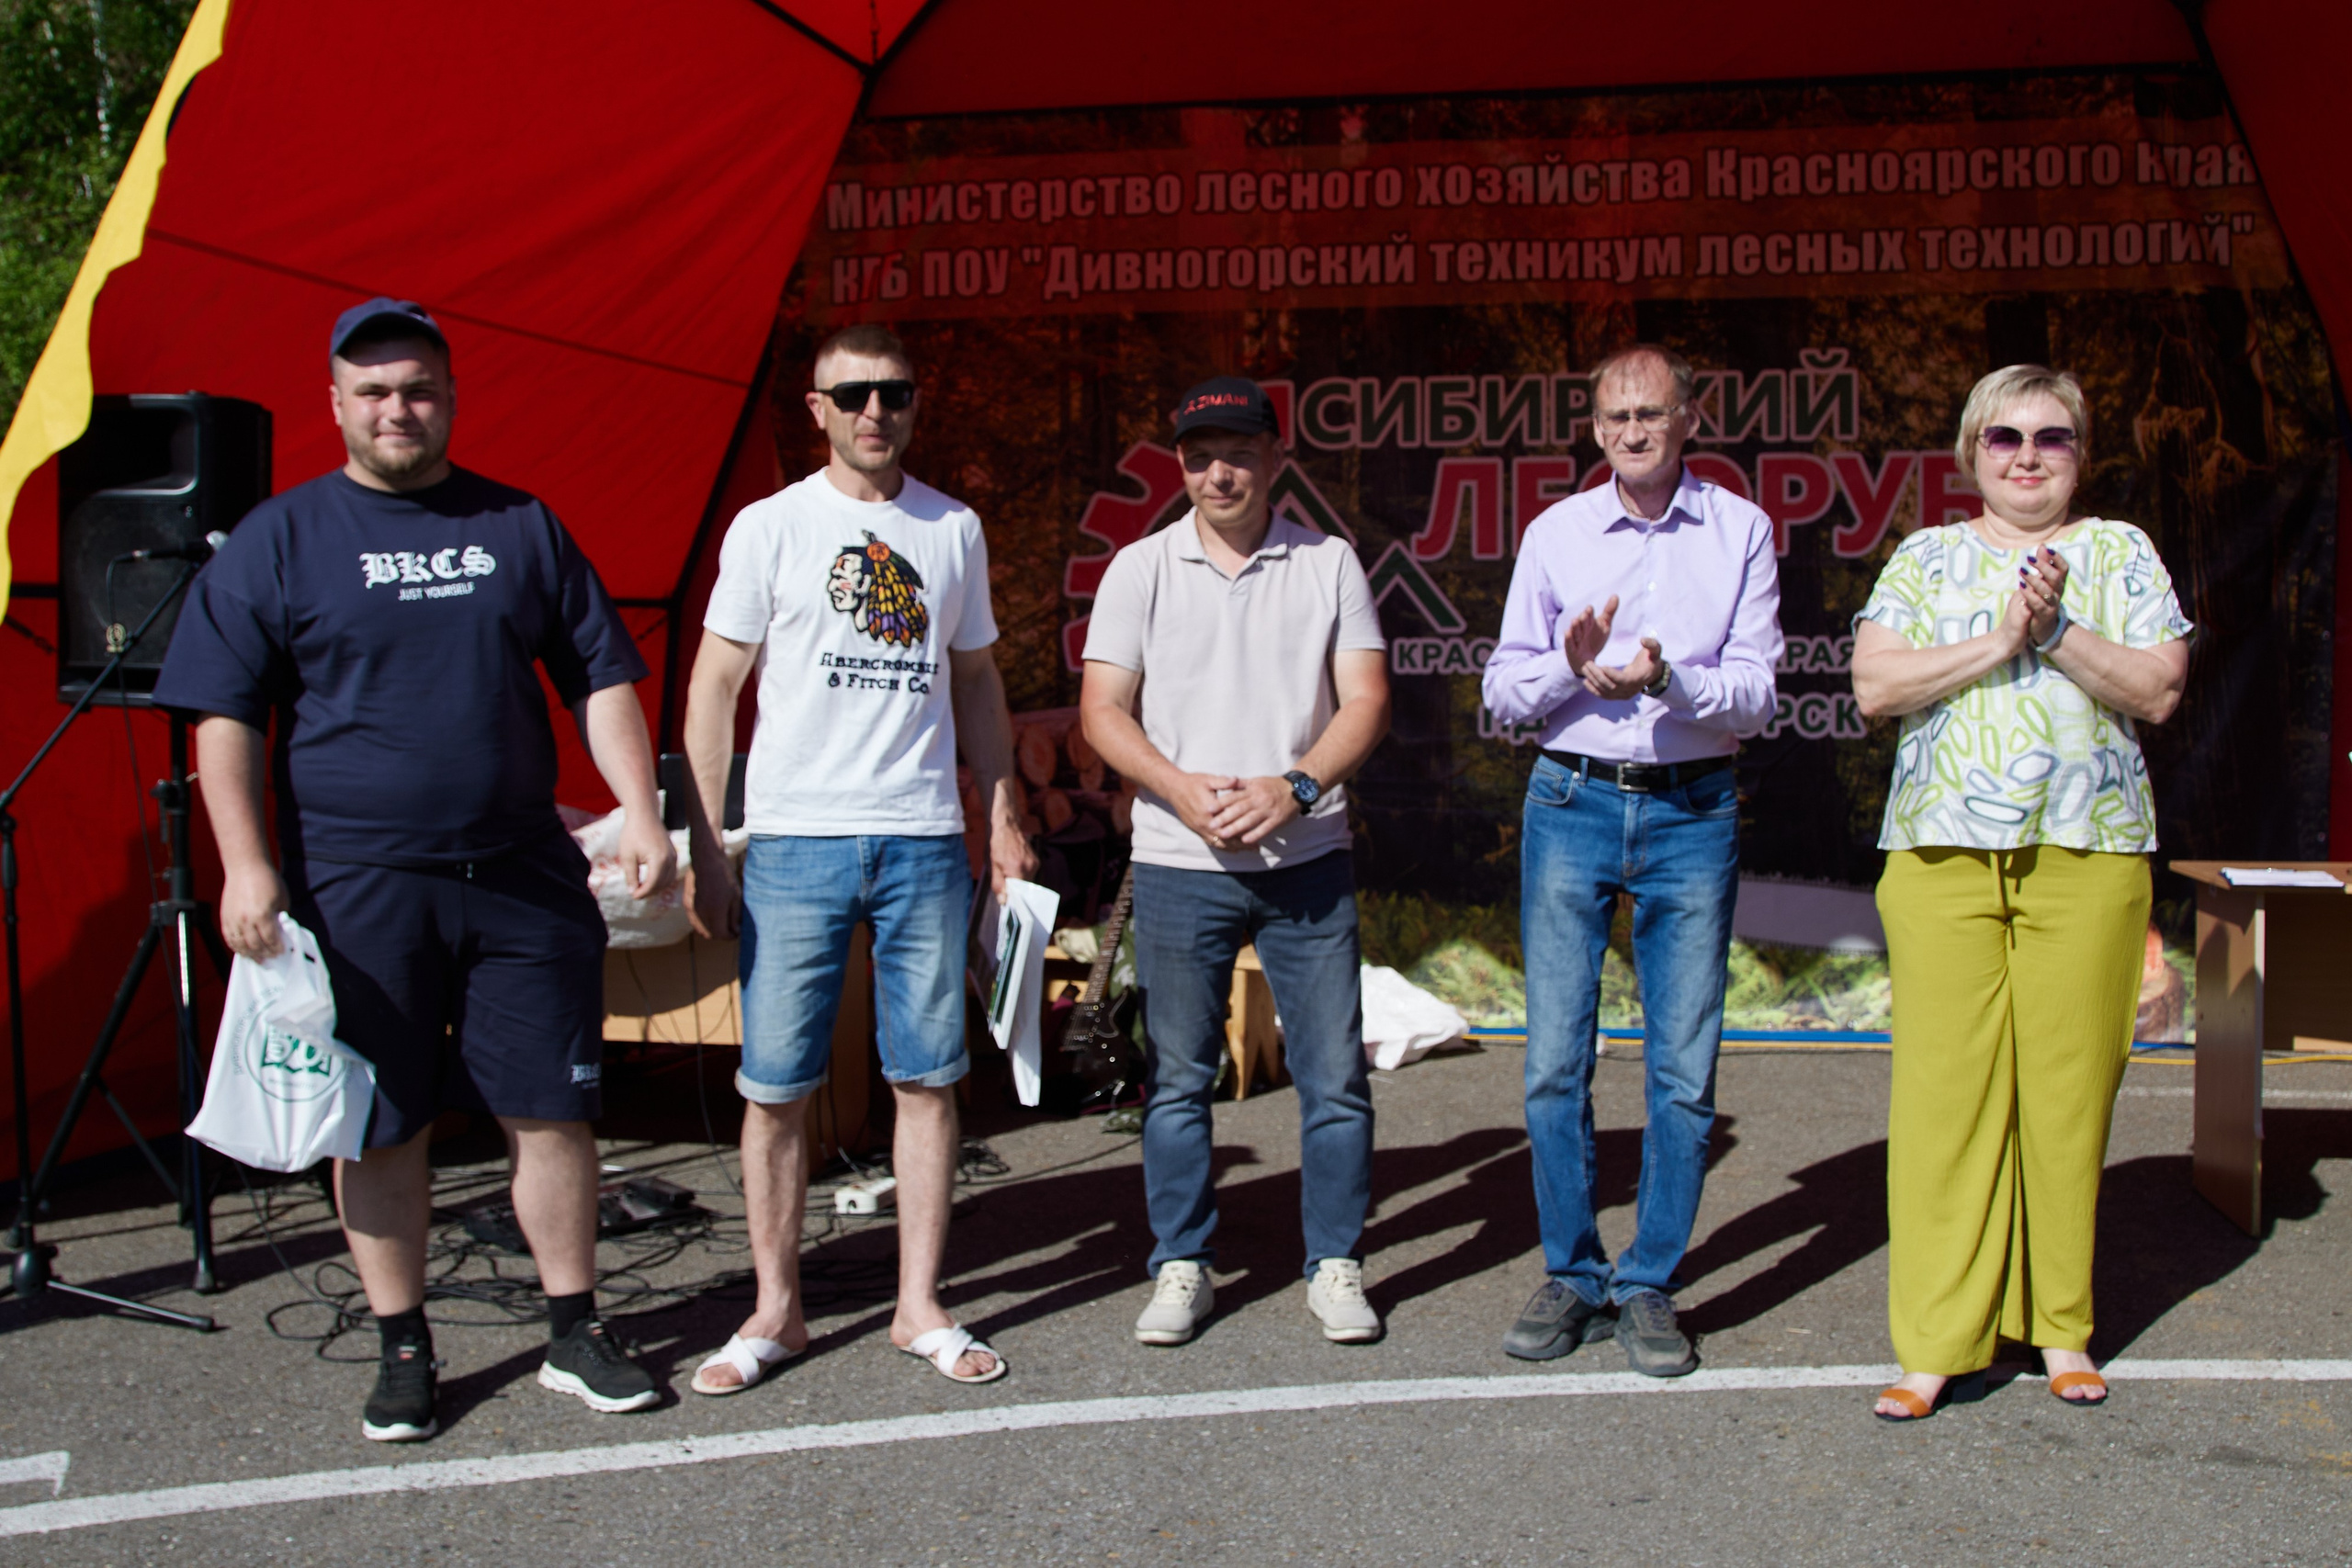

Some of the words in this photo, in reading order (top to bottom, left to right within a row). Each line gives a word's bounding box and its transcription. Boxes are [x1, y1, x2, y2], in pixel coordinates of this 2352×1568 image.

[828, 176, 1182, 230] Министерство
[1193, 167, 1403, 213] лесного
[1416, 151, 1692, 208] хозяйства
[1705, 143, 2120, 197] Красноярского
[922, 247, 1010, 299] ПОУ
[1020, 232, 1416, 301] "Дивногорский
[1428, 234, 1683, 285] техникум
[1695, 230, 1908, 276] лесных
[1917, 212, 2254, 273] технологий"
[1297, 349, 1859, 448] СИБИРКИЙ
[398, 588, 424, 602] JUST
[424, 581, 475, 599] YOURSELF
[828, 671, 841, 688] &
[1773, 634, 1856, 675] РАЯ
